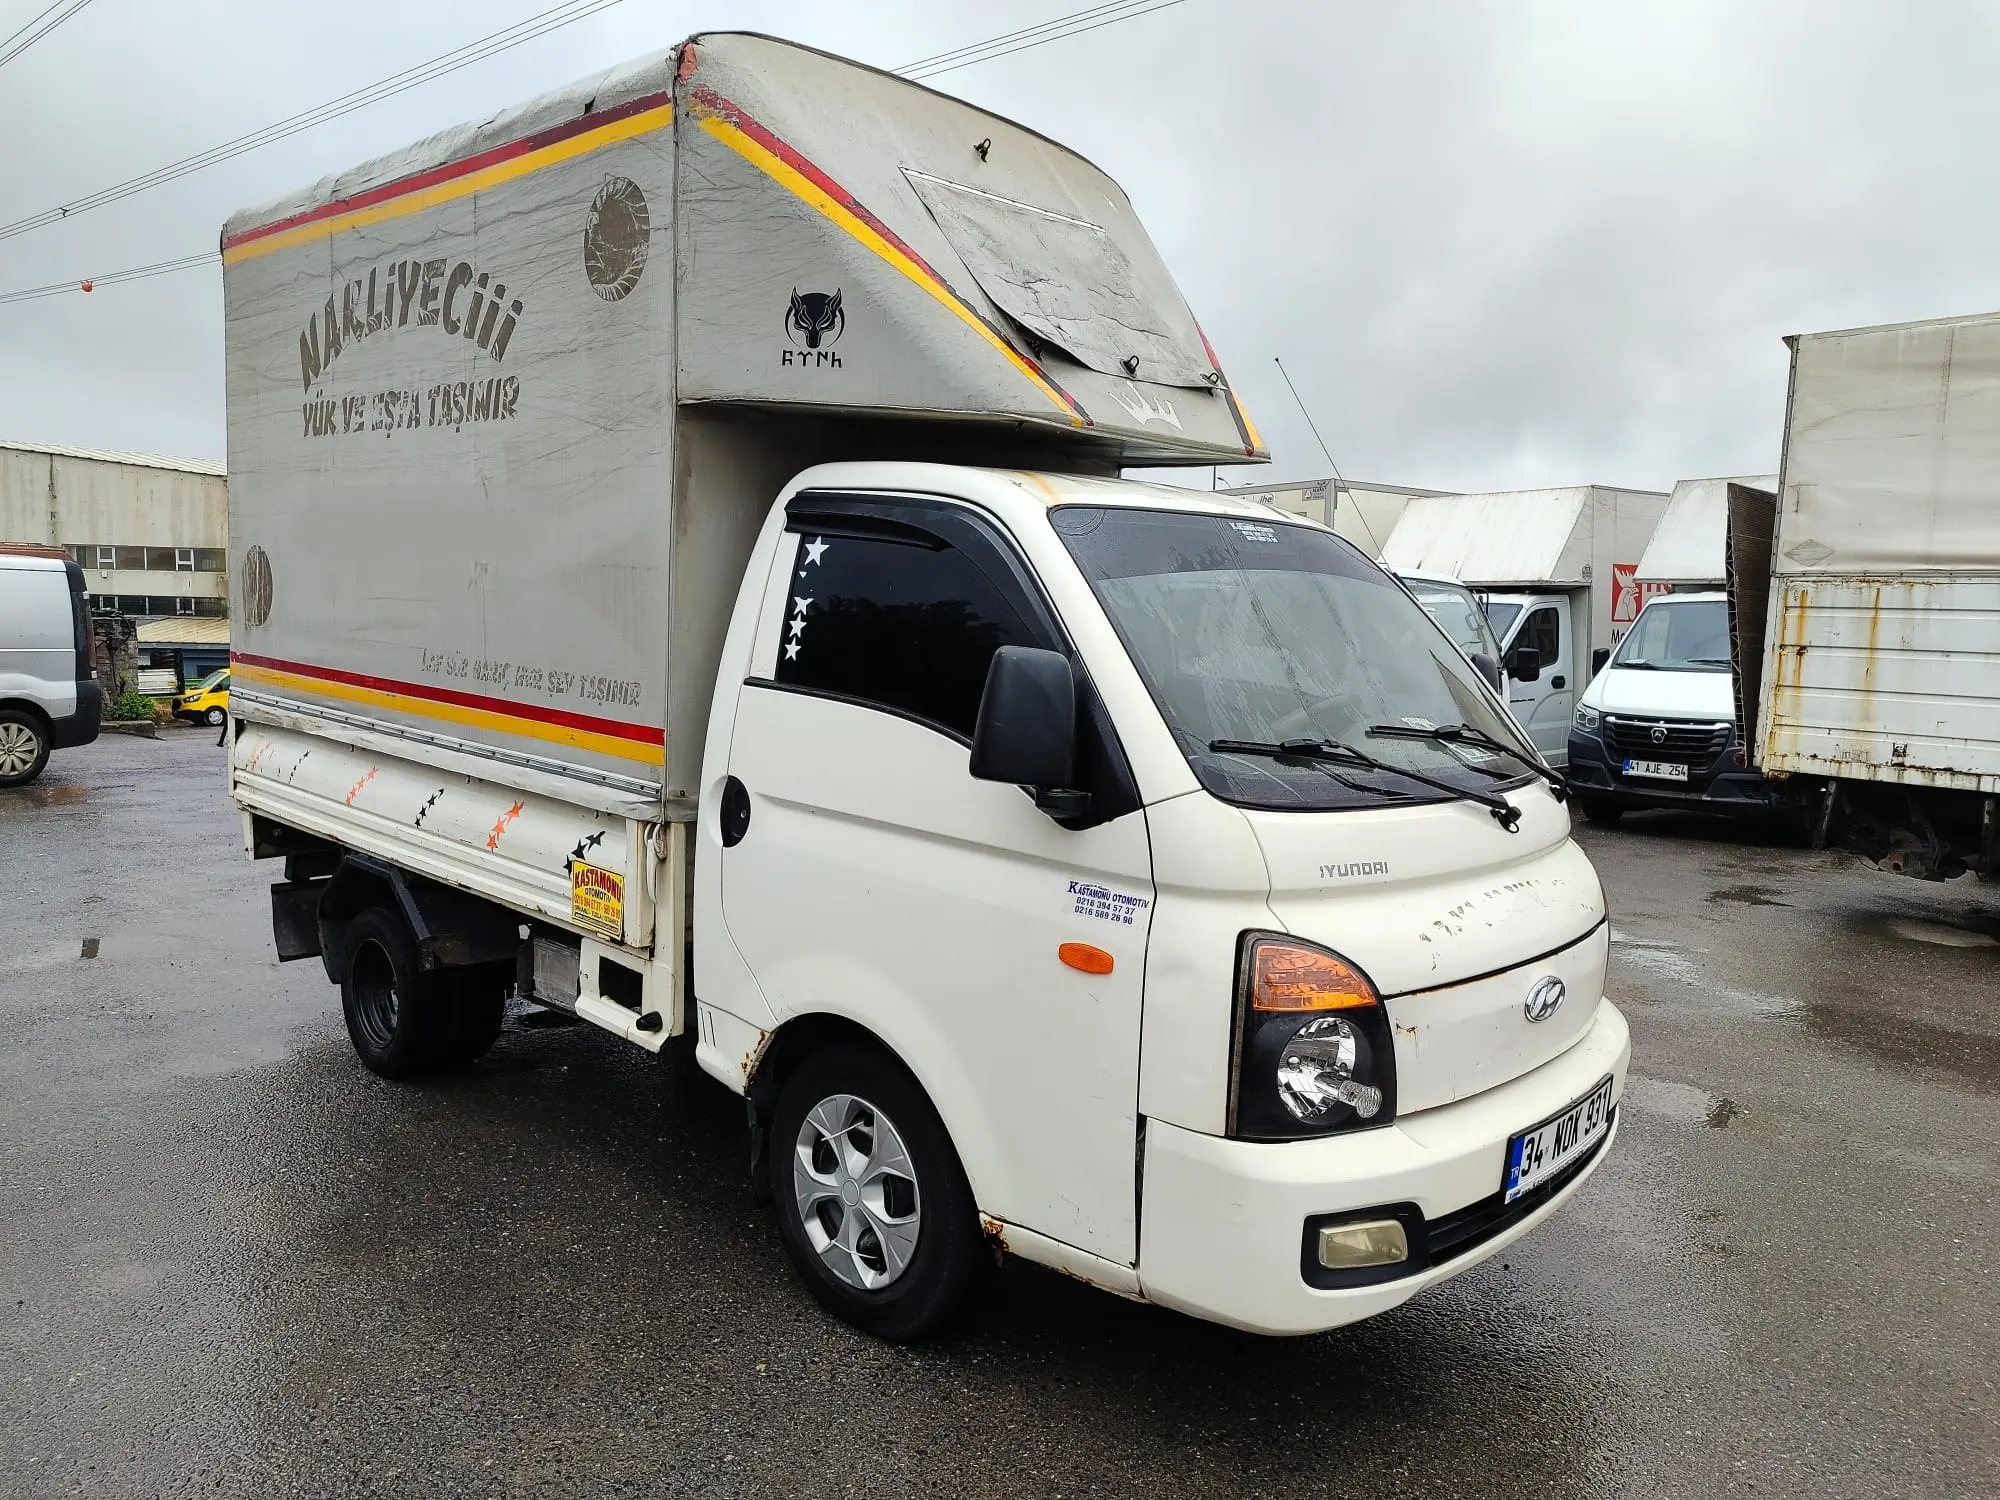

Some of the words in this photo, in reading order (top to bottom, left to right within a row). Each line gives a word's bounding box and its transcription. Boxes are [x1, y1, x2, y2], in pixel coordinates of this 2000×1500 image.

[302, 388, 337, 438] YÜK
[1630, 761, 1639, 772] 41
[1645, 762, 1662, 774] AJE
[1668, 765, 1686, 776] 254
[575, 868, 622, 903] KASTAMONU
[1067, 880, 1111, 902] KASTAMONU
[1075, 905, 1093, 916] 0216
[1094, 909, 1109, 920] 589
[1123, 915, 1133, 925] 90
[1076, 896, 1095, 907] 0216
[1096, 900, 1111, 910] 394
[1113, 904, 1123, 913] 57
[1125, 906, 1136, 916] 37
[1520, 1131, 1544, 1178] 34
